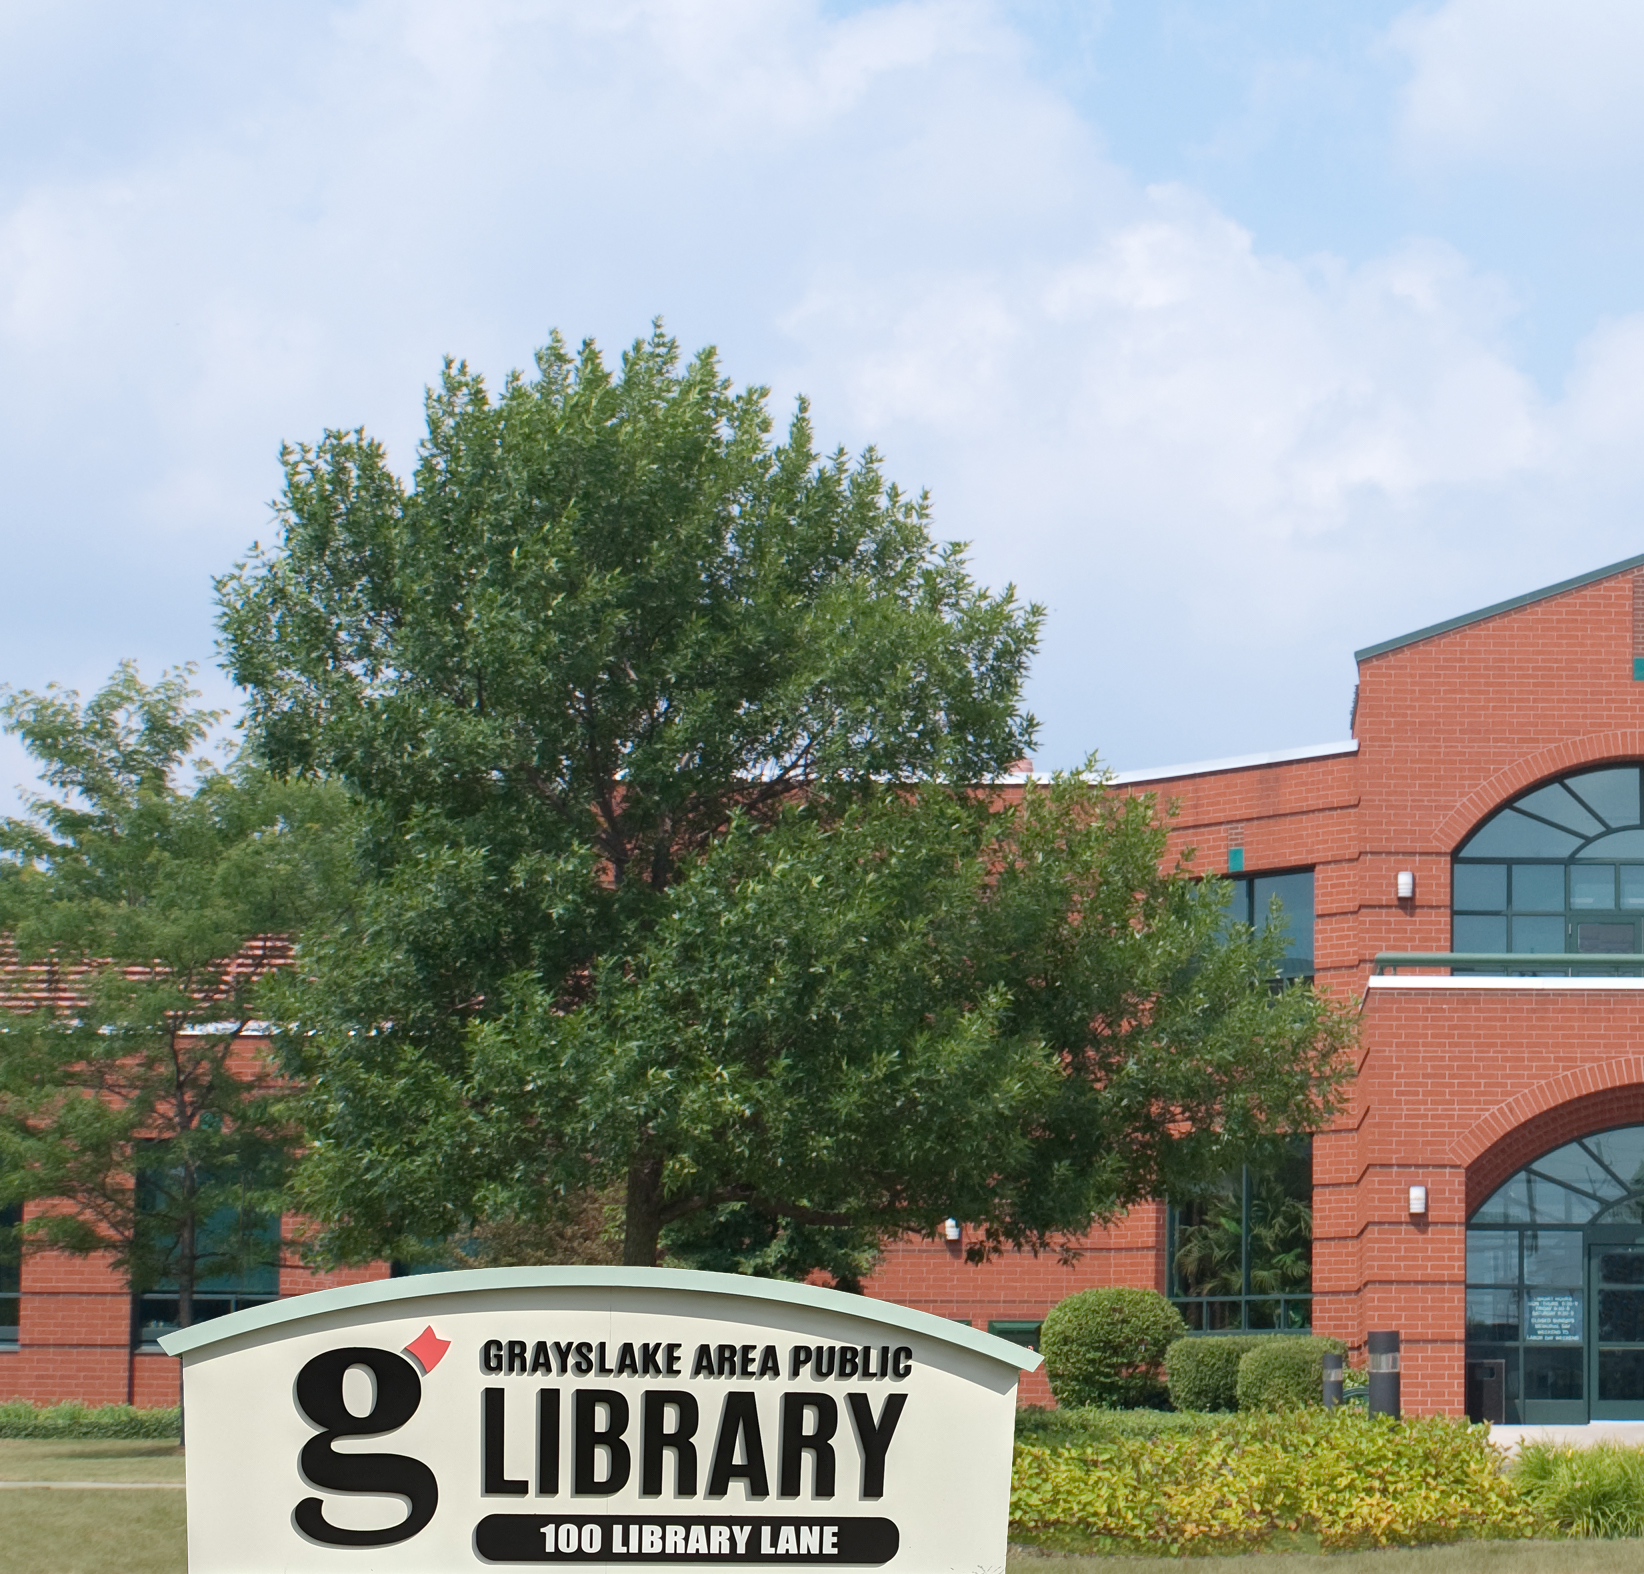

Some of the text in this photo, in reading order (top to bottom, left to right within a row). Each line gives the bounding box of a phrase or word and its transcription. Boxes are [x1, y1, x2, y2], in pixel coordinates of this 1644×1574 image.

[483, 1339, 913, 1378] GRAYSLAKE AREA PUBLIC
[293, 1346, 440, 1547] g
[483, 1387, 909, 1498] LIBRARY
[539, 1523, 839, 1555] 100 LIBRARY LANE
